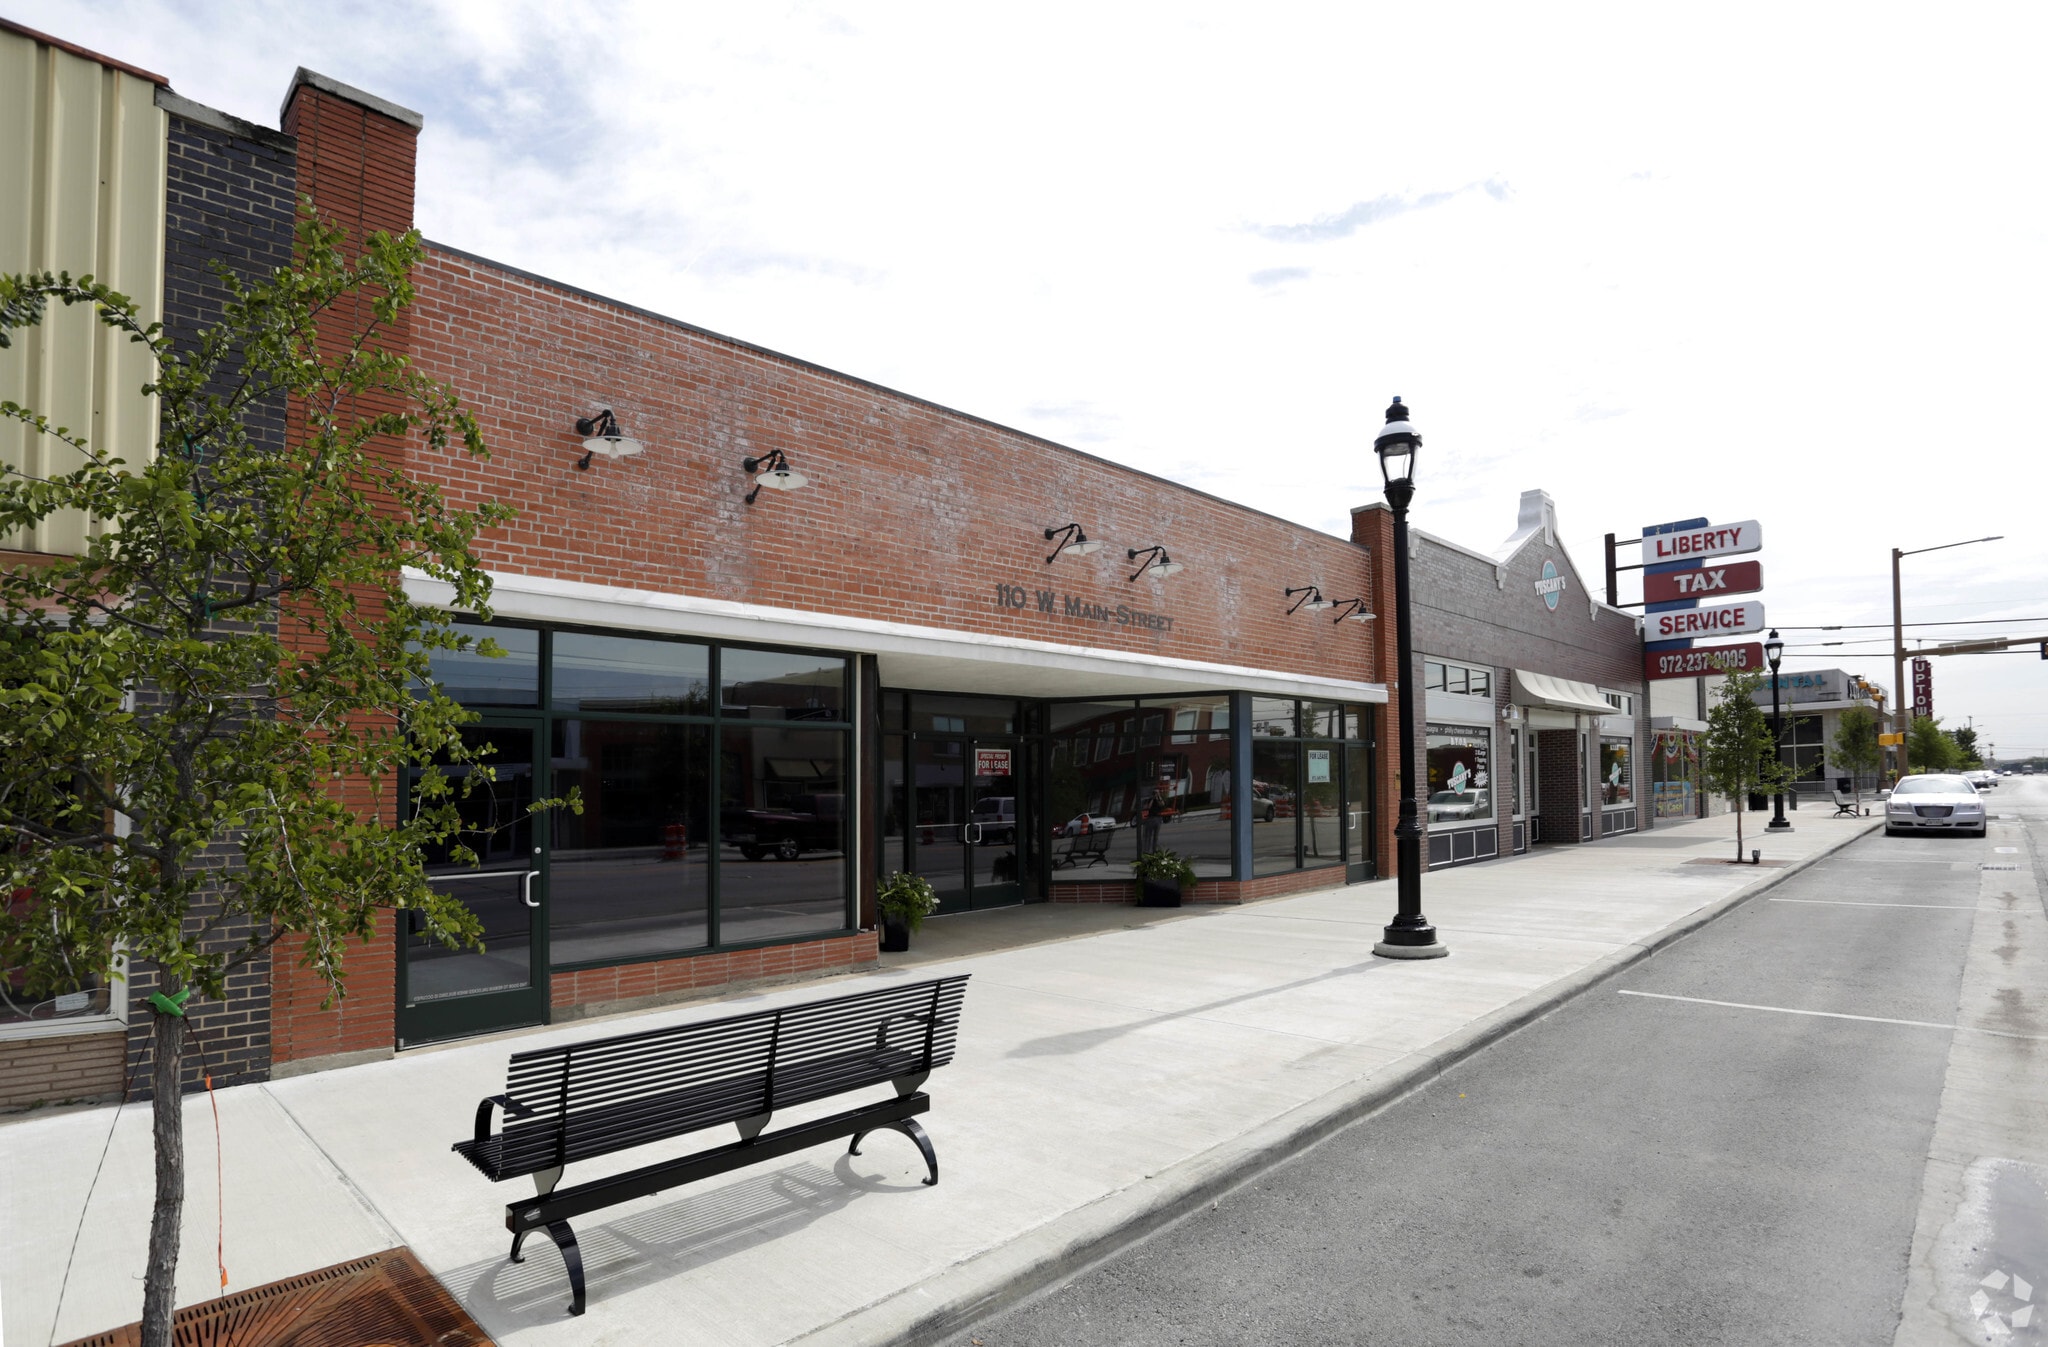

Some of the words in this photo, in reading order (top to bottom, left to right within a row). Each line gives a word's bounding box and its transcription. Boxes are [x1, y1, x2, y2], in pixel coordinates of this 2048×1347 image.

[1657, 528, 1742, 557] LIBERTY
[1673, 569, 1727, 593] TAX
[996, 583, 1027, 609] 110
[1036, 590, 1057, 614] W.
[1064, 594, 1109, 622] MAIN
[1116, 604, 1174, 632] STREET
[1659, 607, 1745, 635] SERVICE
[1915, 662, 1928, 716] UPTOW
